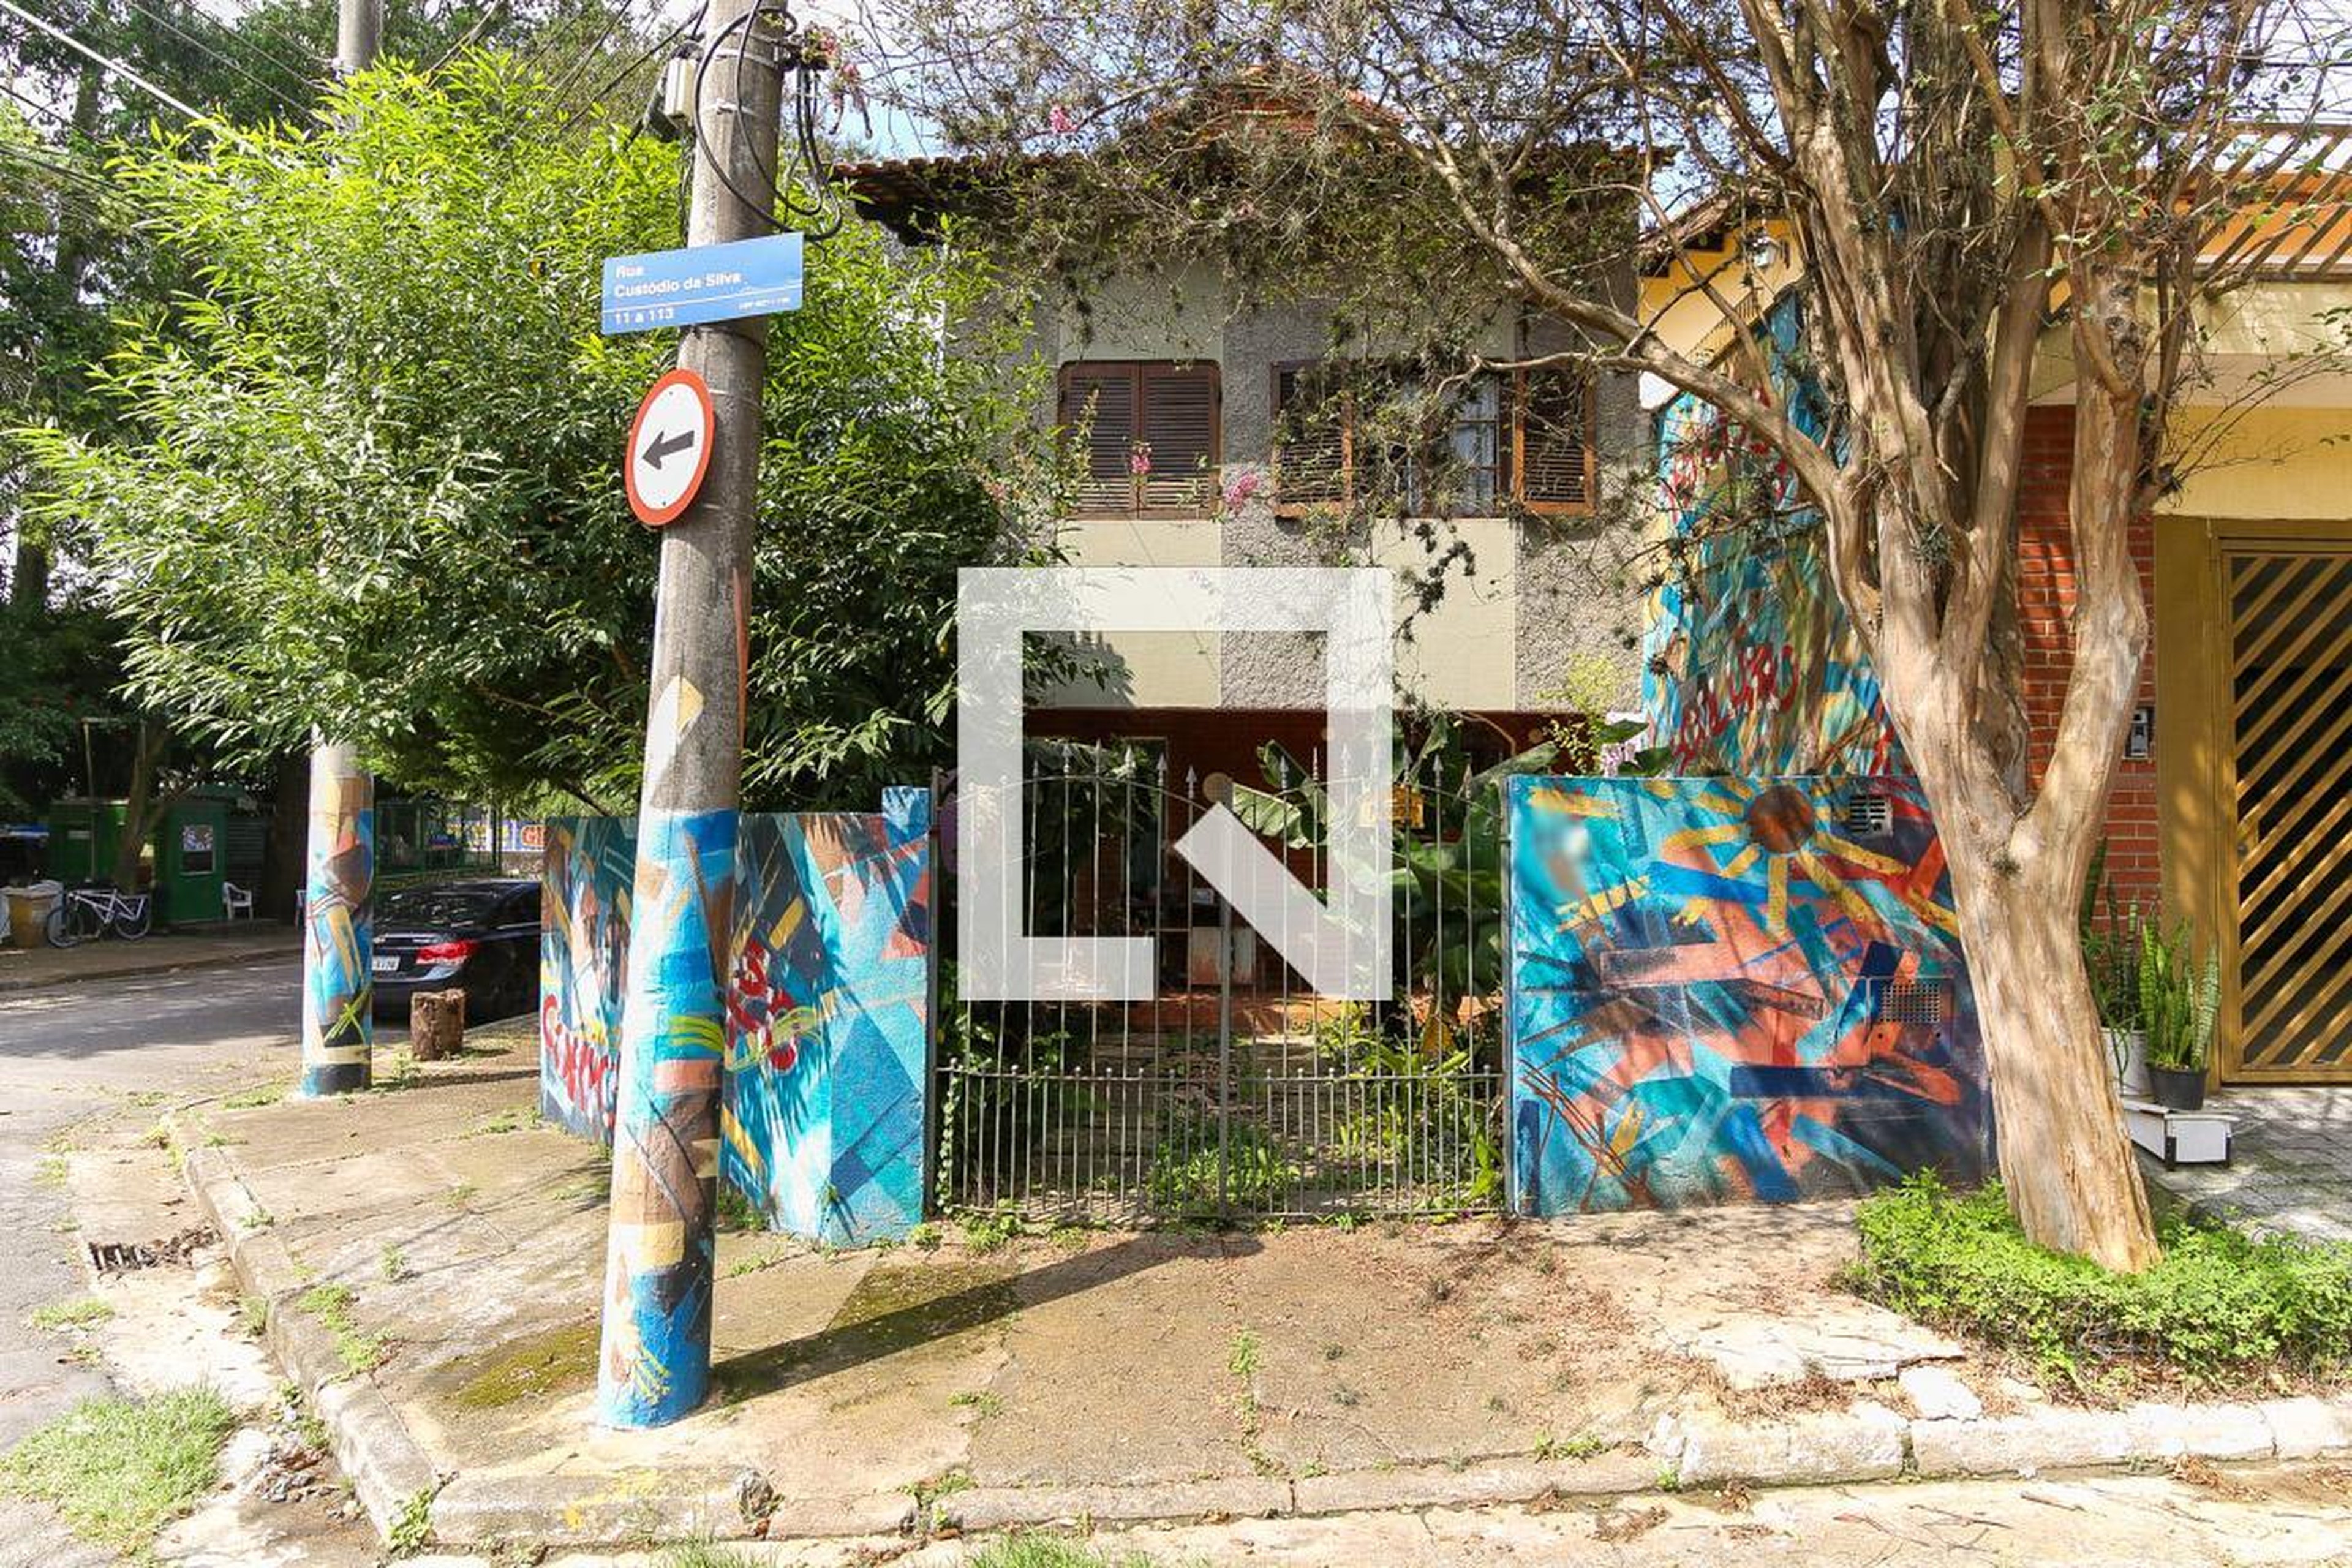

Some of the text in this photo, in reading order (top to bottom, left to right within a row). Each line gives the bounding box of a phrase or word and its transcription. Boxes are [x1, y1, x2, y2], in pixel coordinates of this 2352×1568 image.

[616, 265, 644, 278] Rua
[614, 273, 742, 297] Custódio da Silva
[615, 307, 673, 325] 11 a 113
